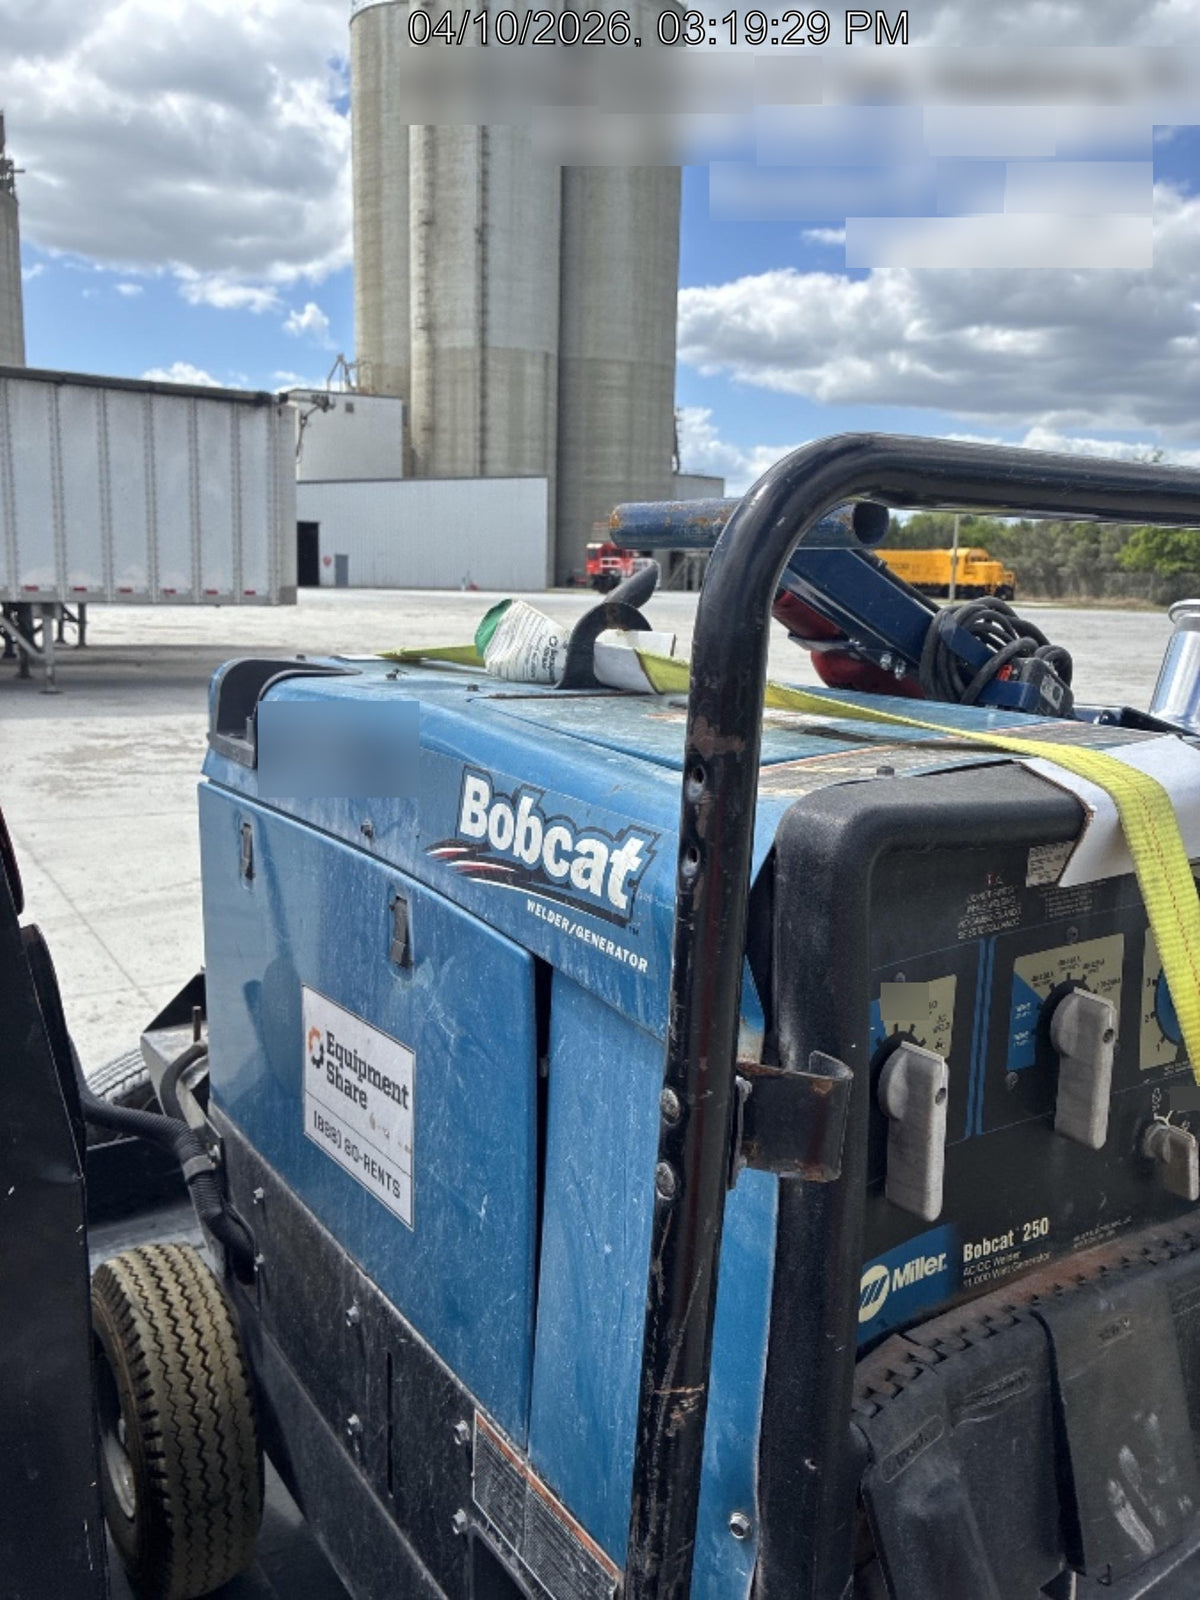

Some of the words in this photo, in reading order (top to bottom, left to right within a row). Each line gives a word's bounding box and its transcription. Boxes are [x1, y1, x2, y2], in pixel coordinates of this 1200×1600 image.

[460, 774, 645, 910] Bobcat
[527, 899, 649, 973] WELDER/GENERATOR
[325, 1030, 410, 1111] Equipment
[325, 1062, 368, 1111] Share
[963, 1230, 1015, 1264] Bobcat
[1022, 1216, 1050, 1242] 250
[891, 1251, 948, 1293] Miller
